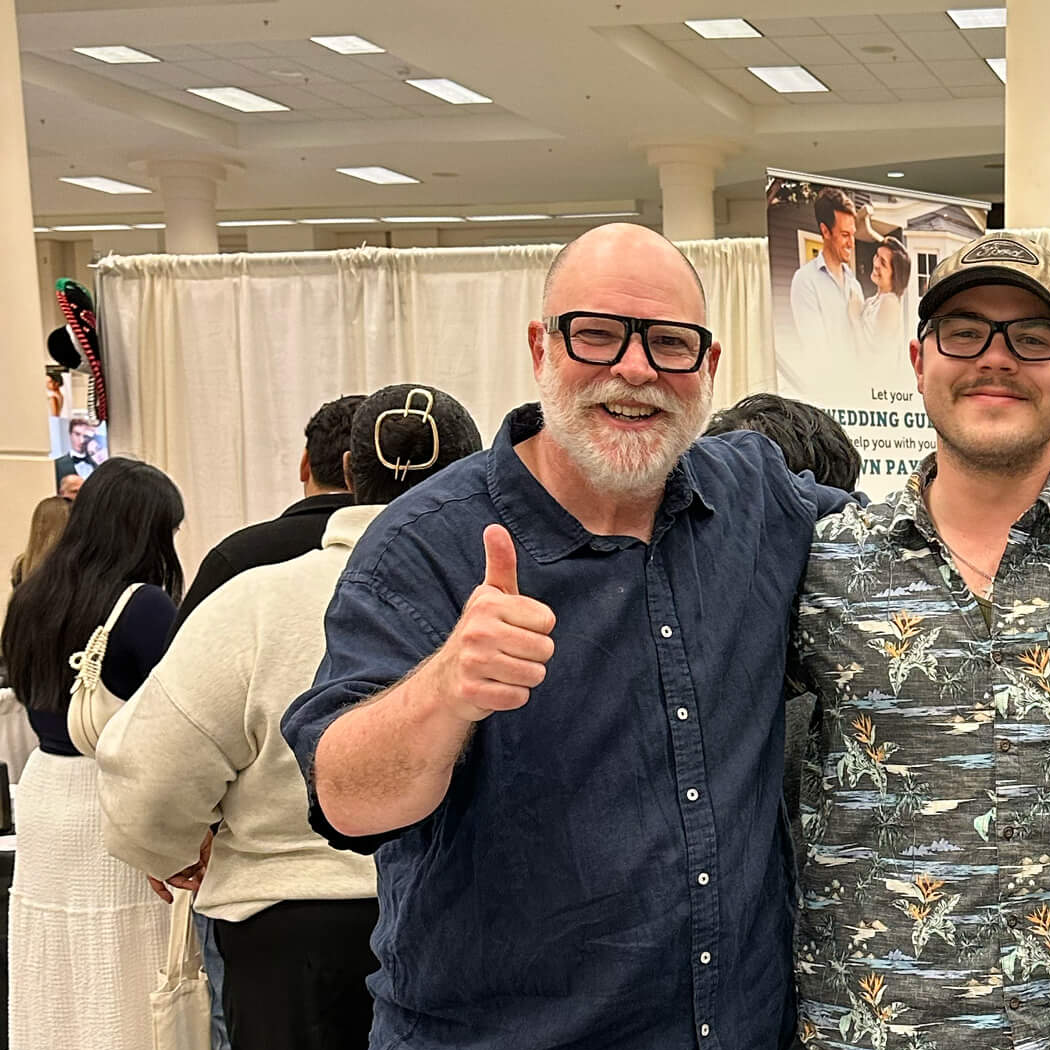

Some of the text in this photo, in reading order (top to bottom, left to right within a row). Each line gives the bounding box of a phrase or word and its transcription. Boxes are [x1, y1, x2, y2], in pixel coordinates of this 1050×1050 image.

[977, 243, 1024, 258] Ford
[871, 388, 914, 404] Let your
[850, 436, 869, 450] elp
[872, 439, 892, 451] you
[894, 437, 916, 449] with
